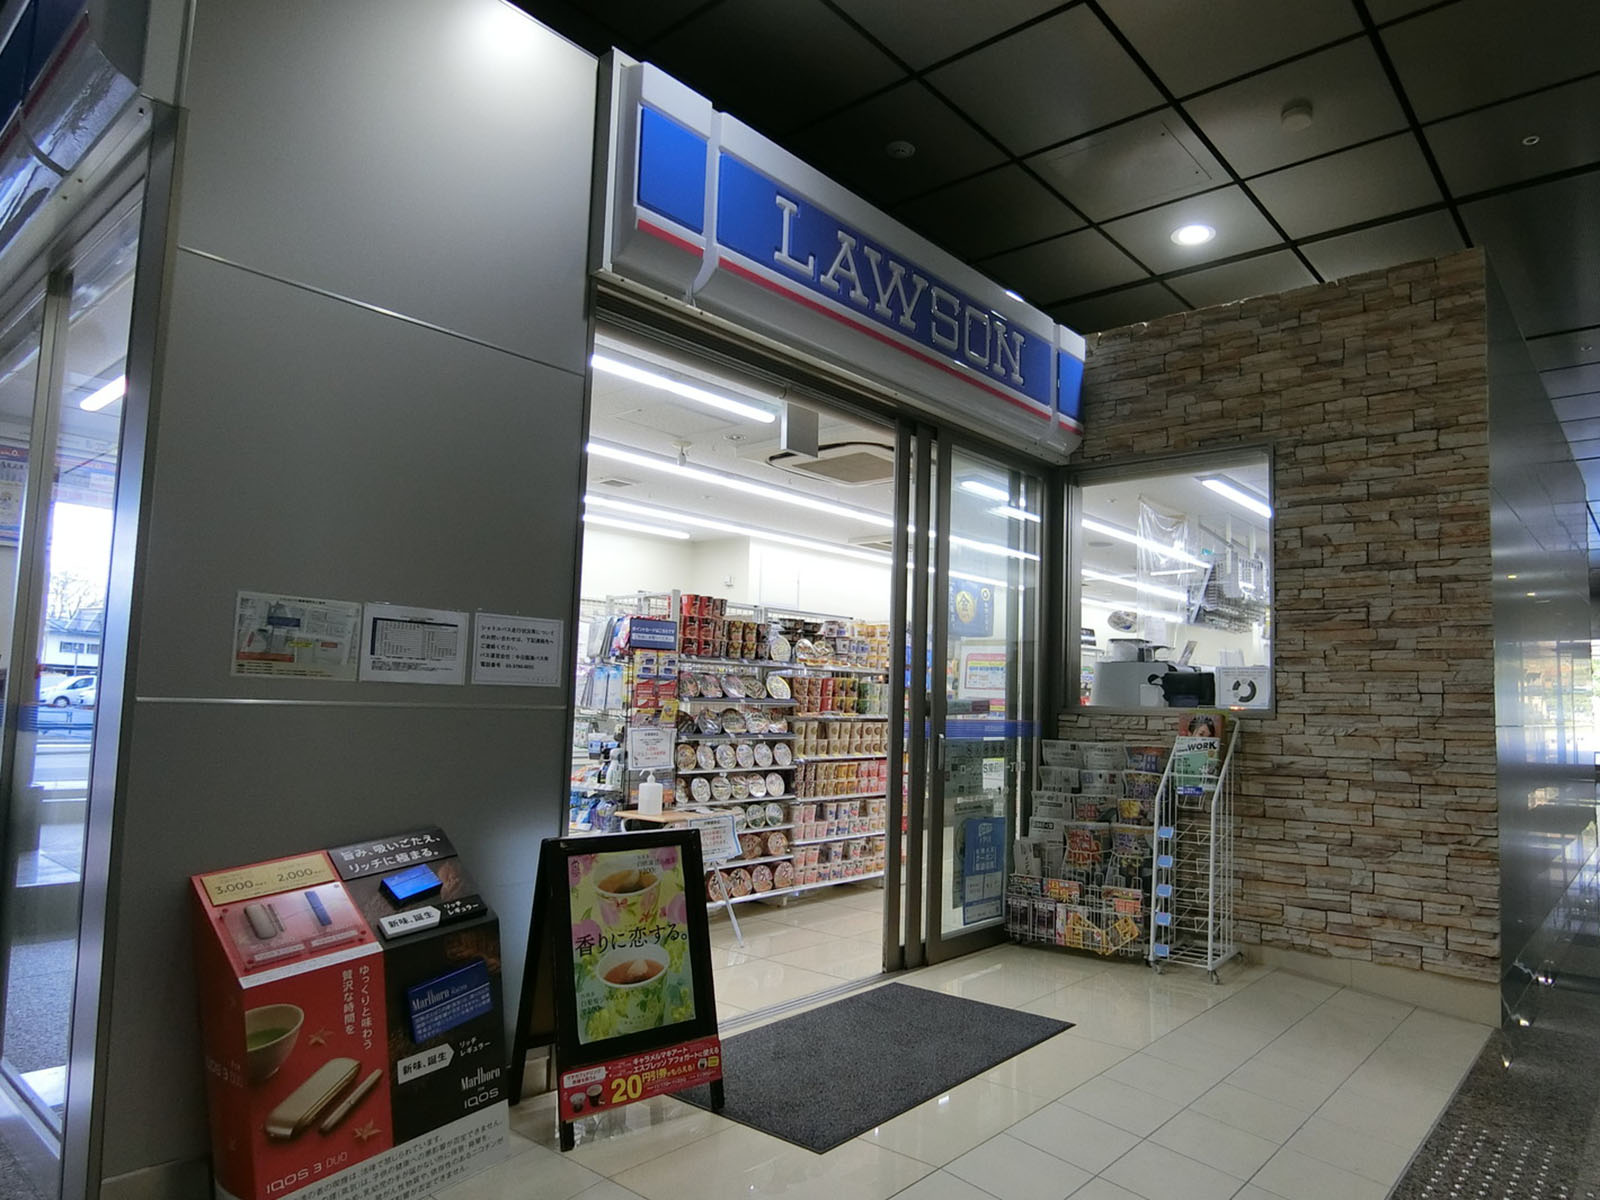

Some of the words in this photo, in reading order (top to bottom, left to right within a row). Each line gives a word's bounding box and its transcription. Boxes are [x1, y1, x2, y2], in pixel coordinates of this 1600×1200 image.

[774, 194, 1025, 385] LAWSON
[1187, 741, 1217, 751] WORK
[348, 847, 440, 873] リッチに極まる。
[575, 922, 688, 958] 香りに恋する。
[360, 965, 373, 1050] ゆっくりと味わう
[412, 988, 451, 1011] Marlboro
[461, 1066, 501, 1091] Marlboro
[464, 1087, 500, 1109] IQOS
[266, 1168, 310, 1194] IQOS
[313, 1162, 323, 1174] 3
[326, 1151, 348, 1169] DUO
